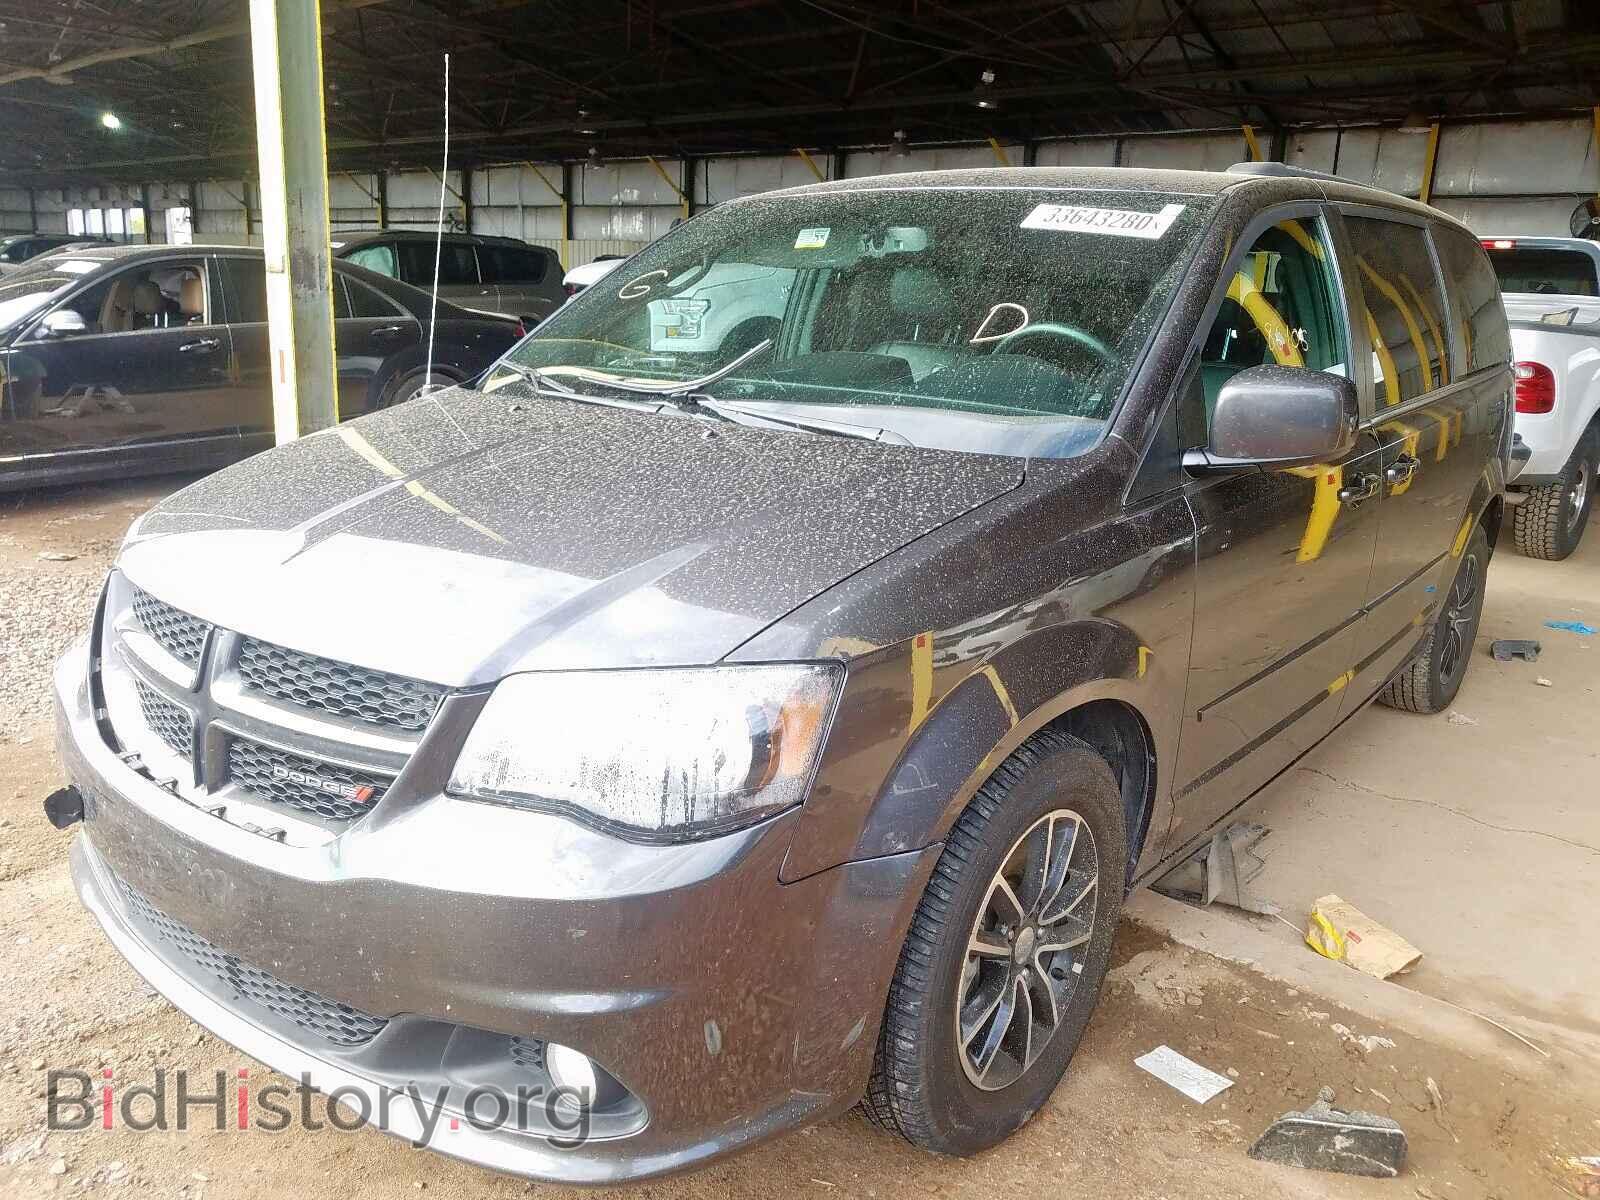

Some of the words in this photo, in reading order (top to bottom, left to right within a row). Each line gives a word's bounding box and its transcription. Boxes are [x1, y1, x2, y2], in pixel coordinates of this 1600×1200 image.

[1042, 206, 1154, 231] 33643280
[619, 269, 668, 299] G
[272, 765, 356, 801] DODGE
